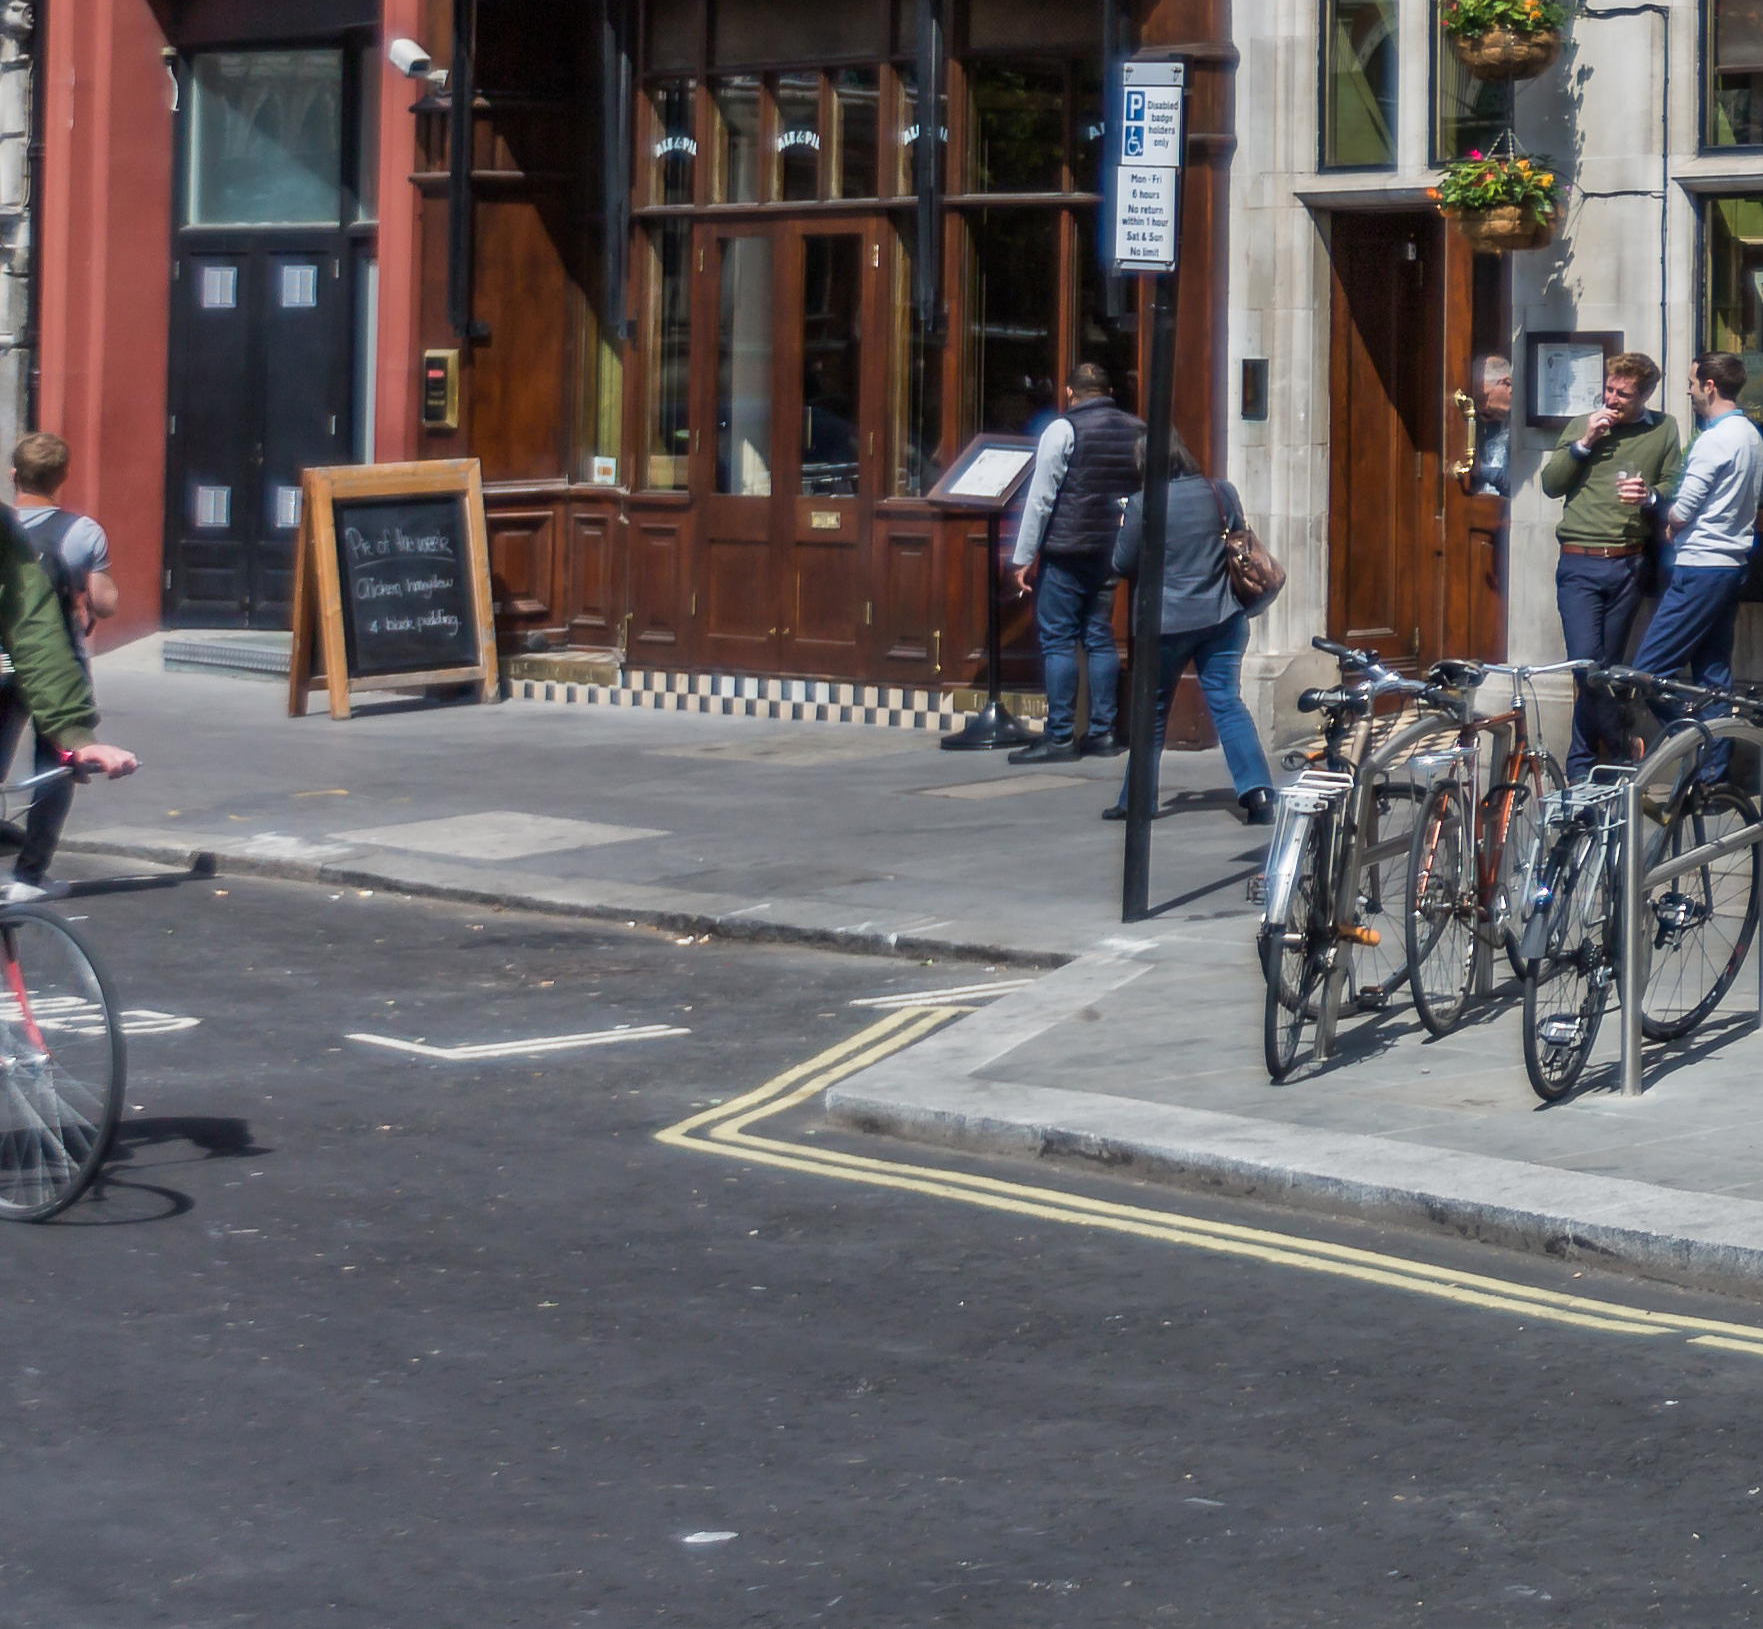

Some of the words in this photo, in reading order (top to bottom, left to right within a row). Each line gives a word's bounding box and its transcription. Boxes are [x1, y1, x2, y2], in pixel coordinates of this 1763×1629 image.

[1130, 94, 1143, 119] P
[1147, 100, 1179, 111] Disabled
[1151, 114, 1174, 124] badge
[1148, 125, 1176, 135] holders
[1154, 138, 1170, 149] only
[1130, 174, 1148, 184] Mon
[1152, 174, 1162, 184] Fri
[1132, 188, 1138, 199] 6
[1139, 190, 1160, 200] hours
[1128, 204, 1138, 214] No
[1140, 205, 1164, 215] return
[1122, 216, 1144, 226] within
[1152, 218, 1169, 227] hour
[1126, 231, 1140, 242] Sat
[1141, 232, 1147, 242] &
[1148, 232, 1164, 242] Sun
[1130, 246, 1140, 256] No
[1142, 248, 1160, 257] limit
[377, 529, 391, 555] of
